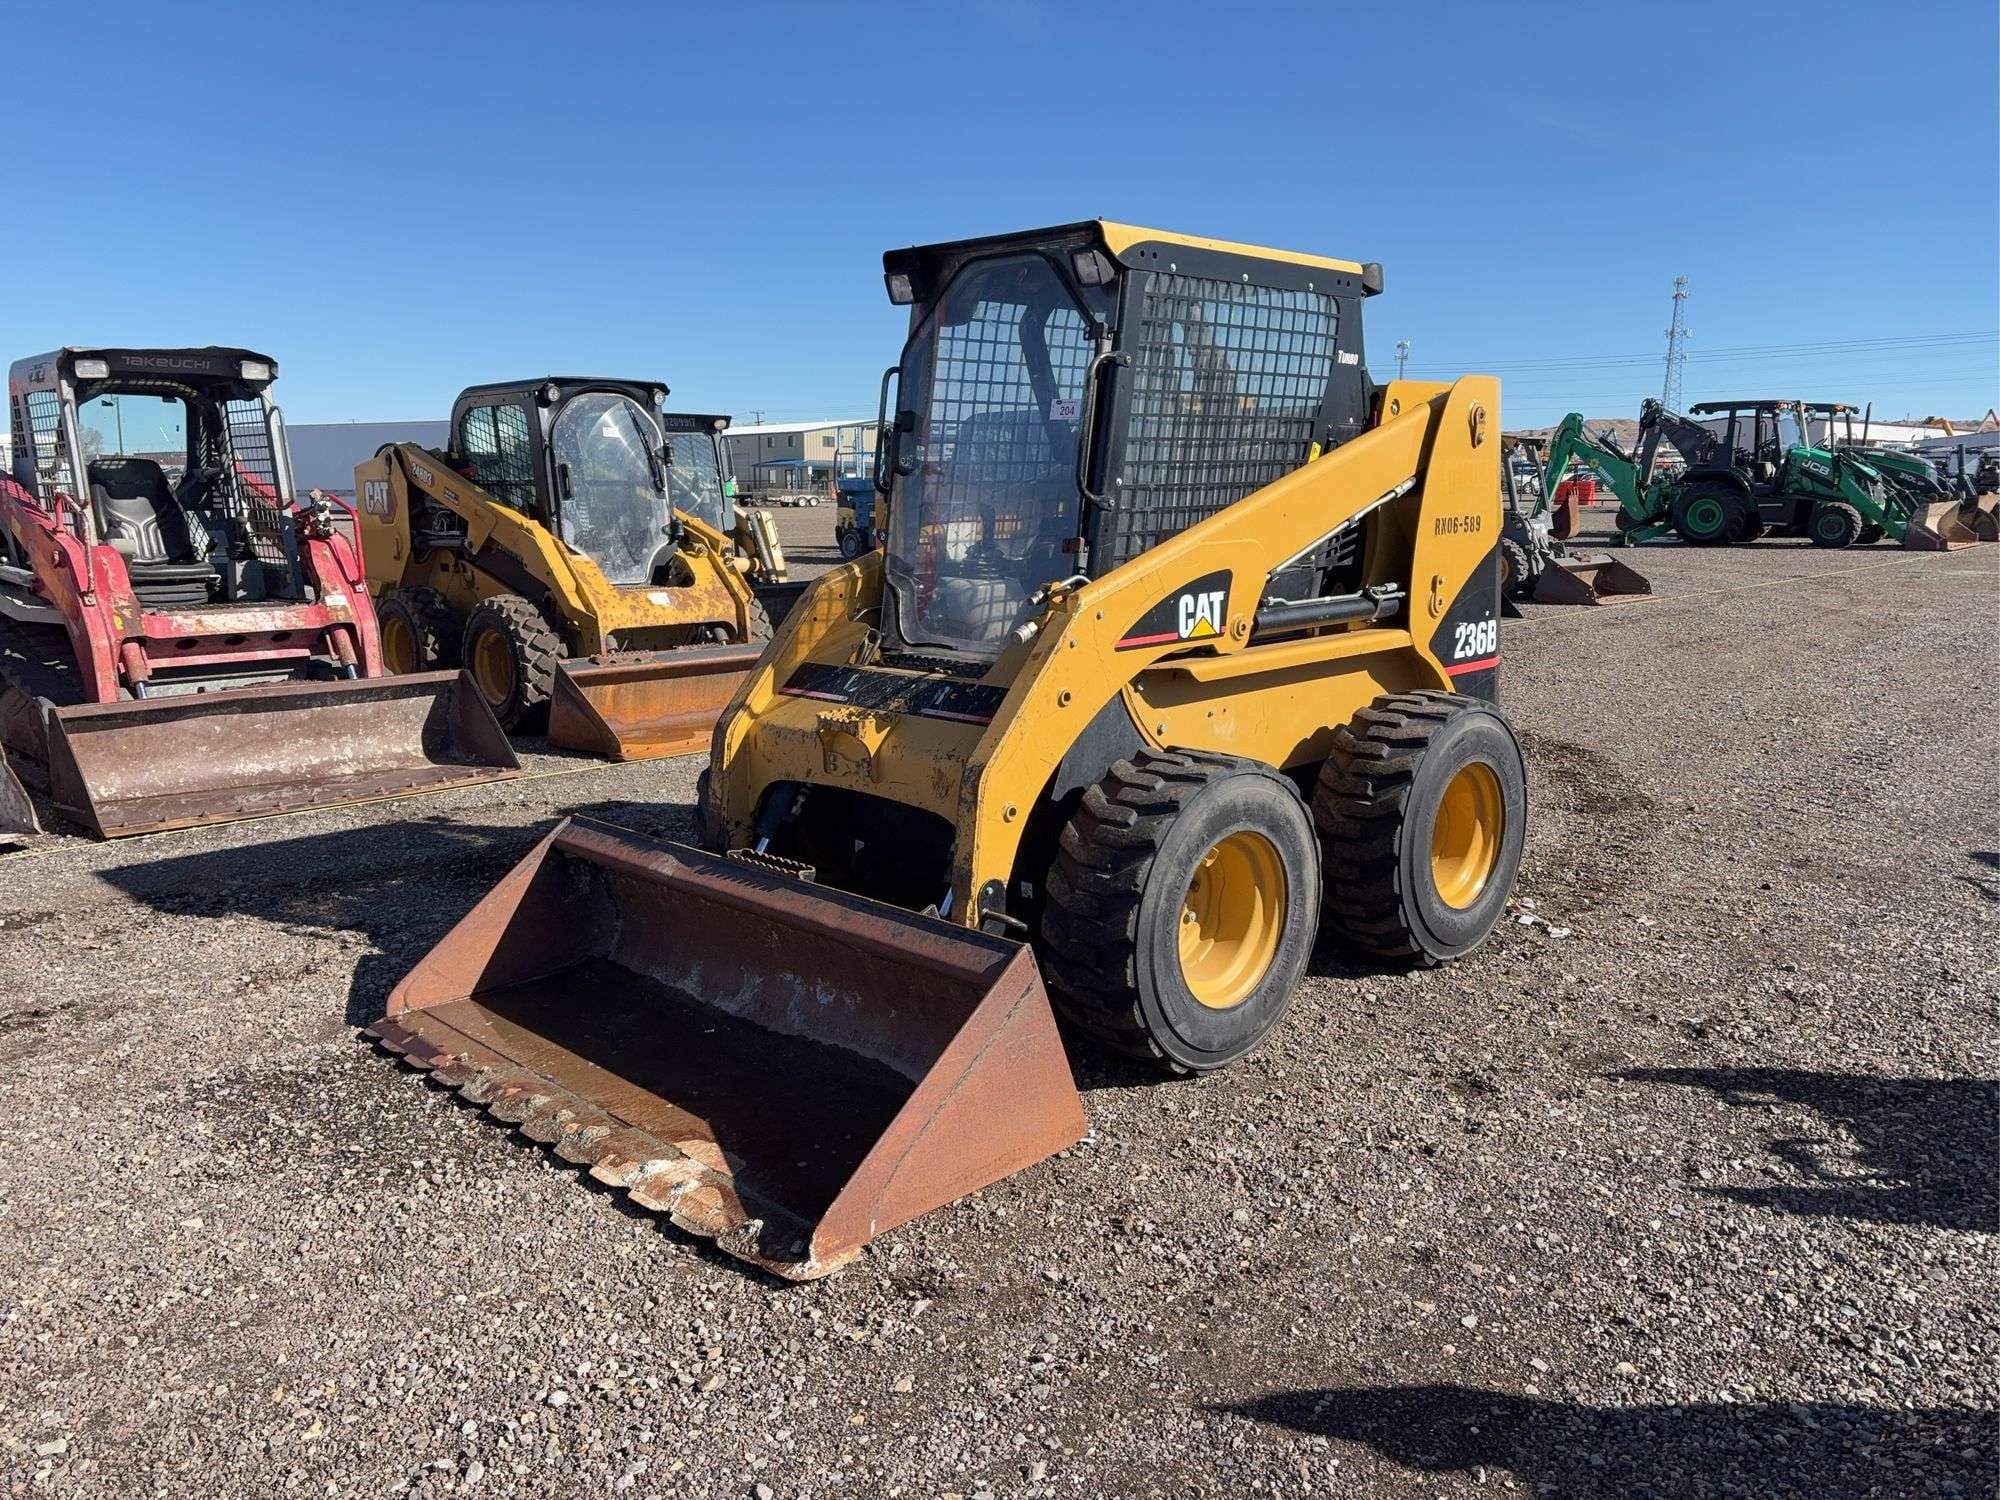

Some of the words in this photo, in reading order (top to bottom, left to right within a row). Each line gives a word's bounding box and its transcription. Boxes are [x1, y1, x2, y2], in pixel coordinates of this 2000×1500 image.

[121, 356, 210, 369] TAKEUCHI
[1802, 460, 1831, 476] JCB
[365, 481, 389, 513] CAT
[1179, 591, 1226, 638] CAT
[1454, 619, 1497, 660] 236B
